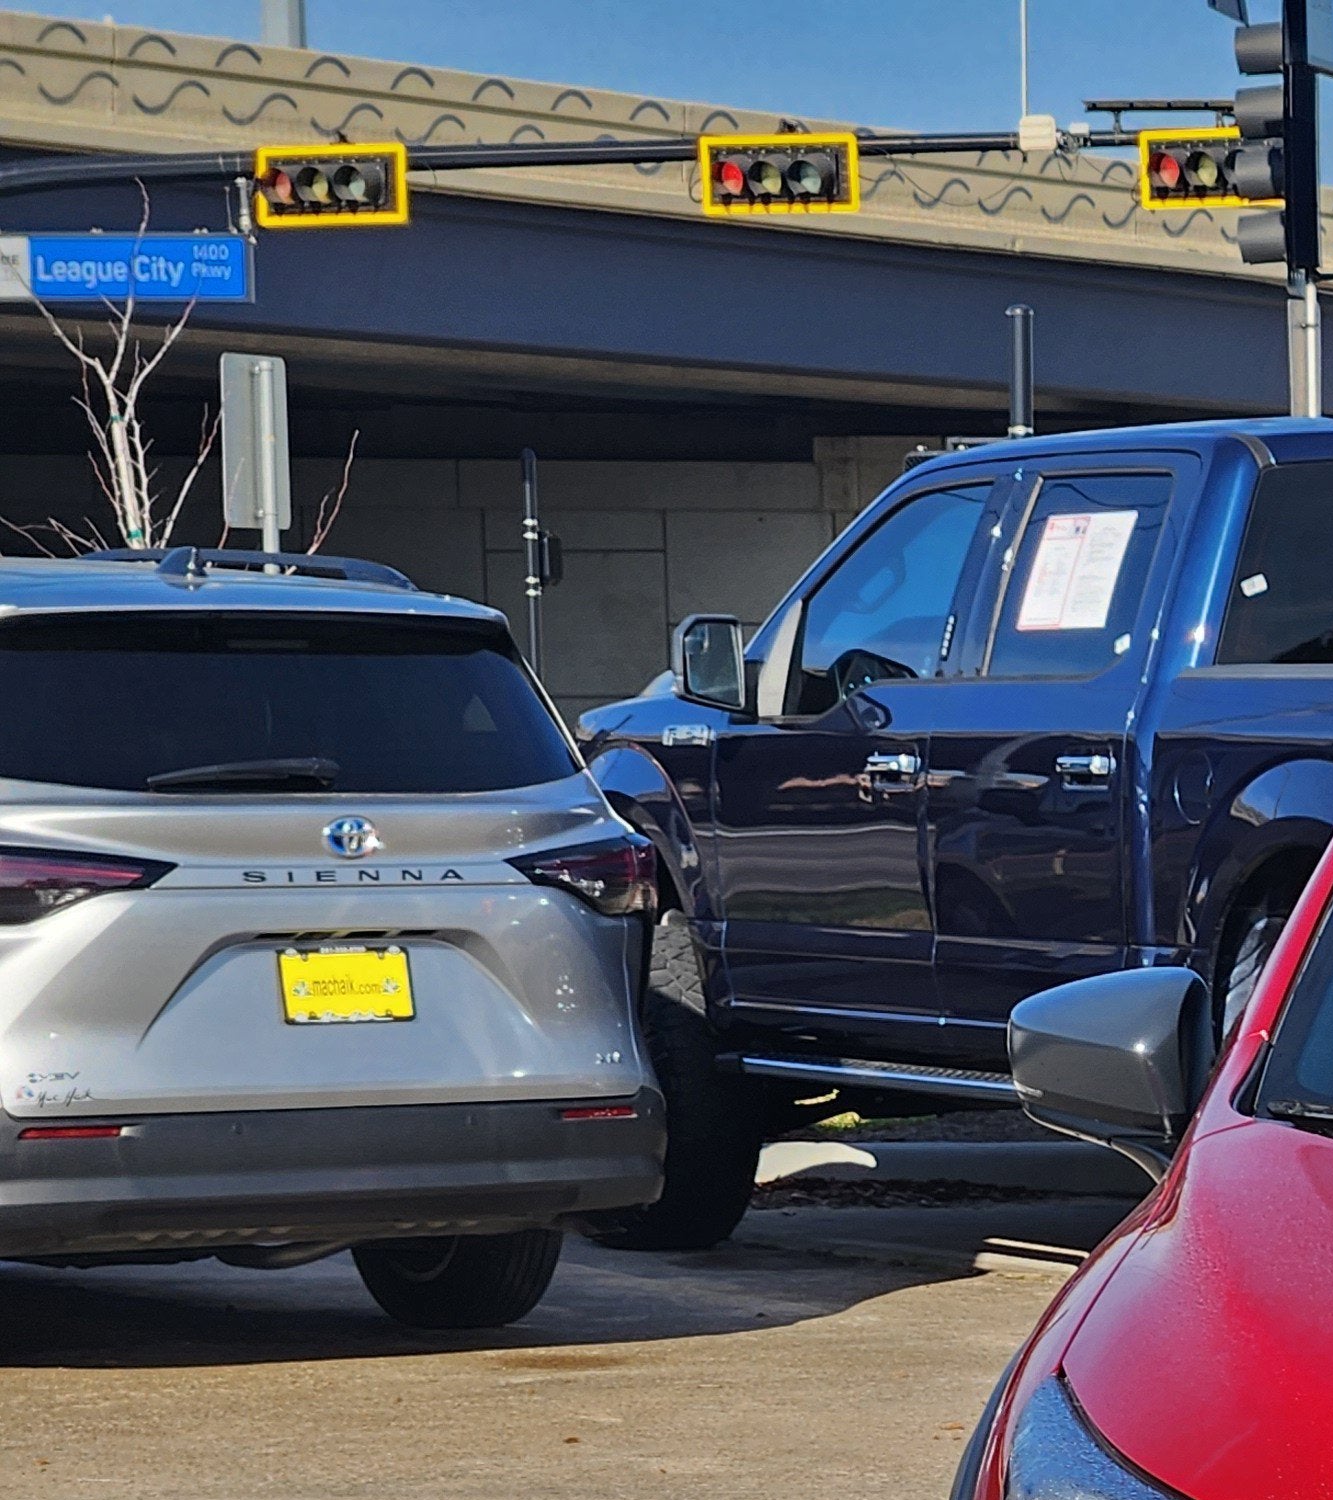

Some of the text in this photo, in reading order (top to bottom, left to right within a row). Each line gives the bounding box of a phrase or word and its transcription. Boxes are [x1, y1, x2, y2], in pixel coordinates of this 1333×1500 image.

[192, 244, 230, 261] 1400
[36, 255, 185, 289] League City
[191, 262, 232, 281] Pkwy
[242, 868, 464, 884] SIENNA
[312, 974, 381, 997] machaik.com
